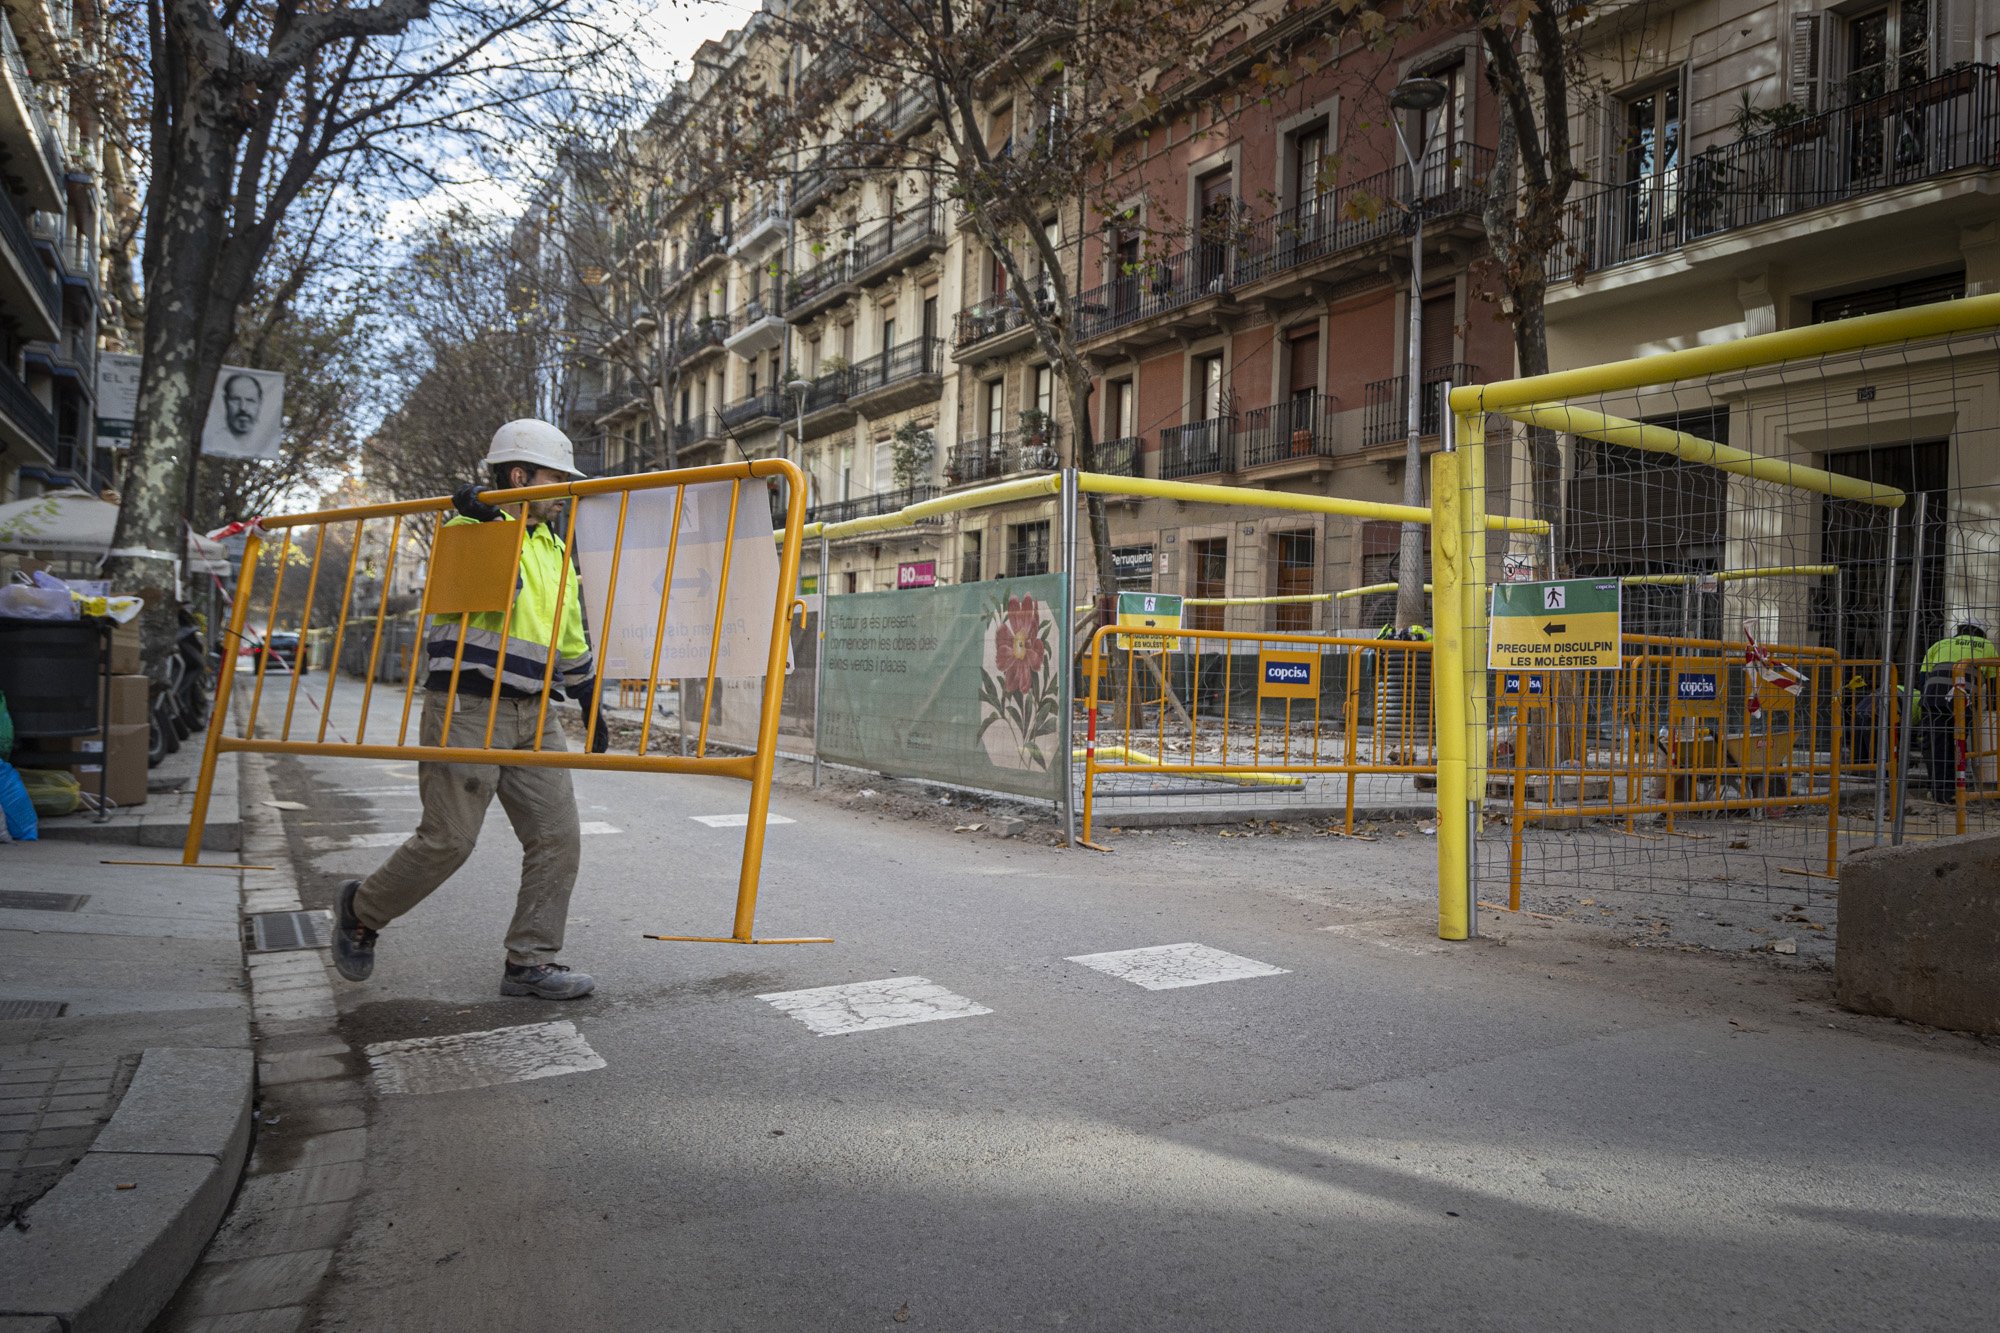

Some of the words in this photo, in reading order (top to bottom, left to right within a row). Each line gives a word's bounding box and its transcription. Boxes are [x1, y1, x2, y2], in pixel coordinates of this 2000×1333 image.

[1496, 643, 1551, 653] PREGUEM
[1553, 641, 1613, 653] DISCULPIN
[1510, 656, 1531, 666] LES
[1534, 654, 1598, 667] MOLÈSTIES
